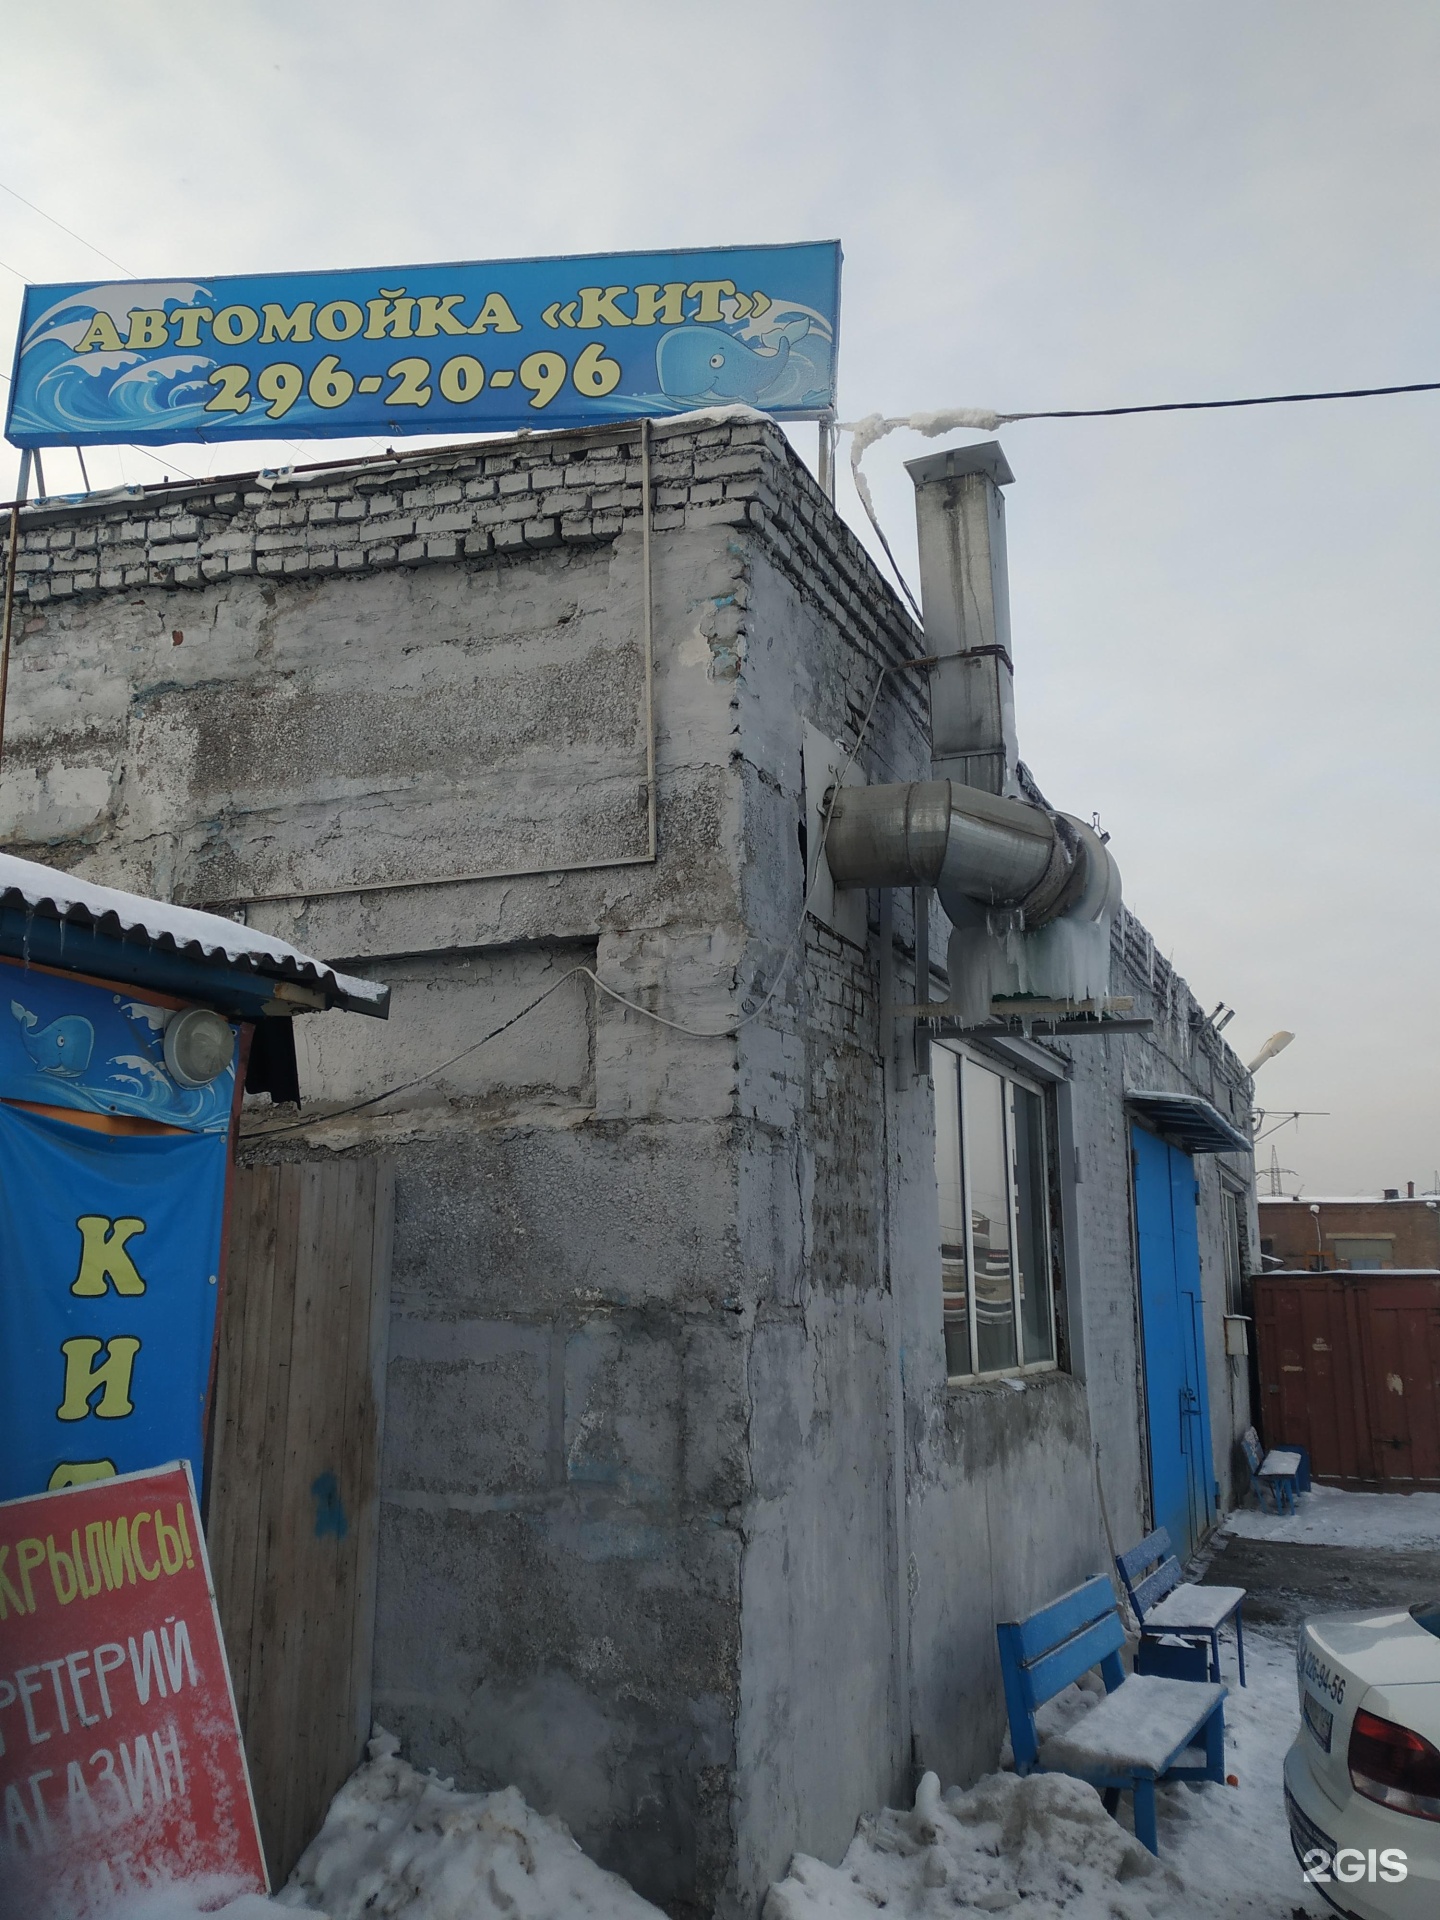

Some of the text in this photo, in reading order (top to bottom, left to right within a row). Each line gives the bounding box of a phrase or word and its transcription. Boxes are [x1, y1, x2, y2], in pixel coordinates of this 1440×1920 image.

[75, 279, 772, 352] АВТОМОЙКА «КИТ»
[204, 341, 622, 419] 296-20-96
